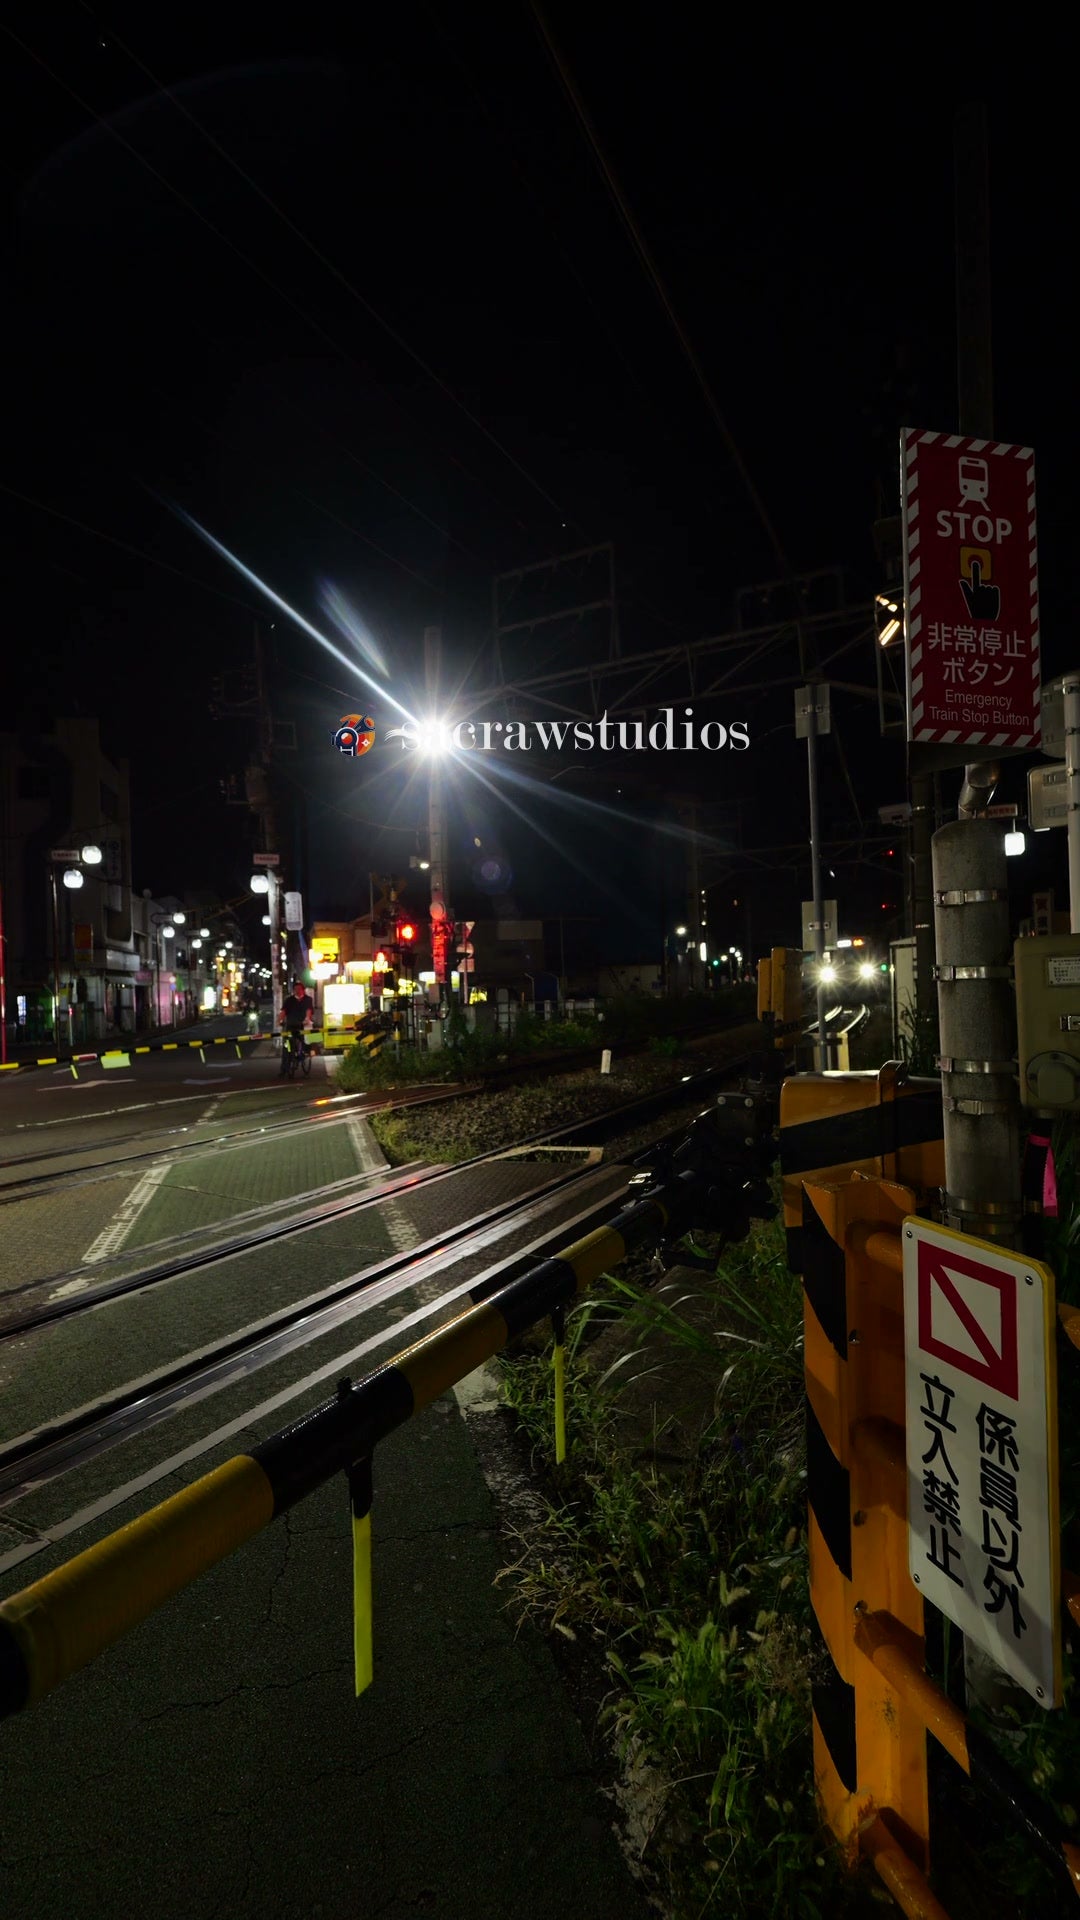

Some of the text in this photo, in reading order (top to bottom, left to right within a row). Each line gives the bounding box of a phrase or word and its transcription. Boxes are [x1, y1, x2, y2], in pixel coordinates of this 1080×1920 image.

[936, 510, 1013, 544] STOP
[928, 622, 1027, 659] 非常停止
[942, 657, 1014, 687] ボタン
[945, 690, 1012, 708] Emergency
[930, 706, 1030, 727] Train Stop Button
[919, 1372, 964, 1588] 立入禁止
[975, 1402, 1027, 1638] 係員以外
